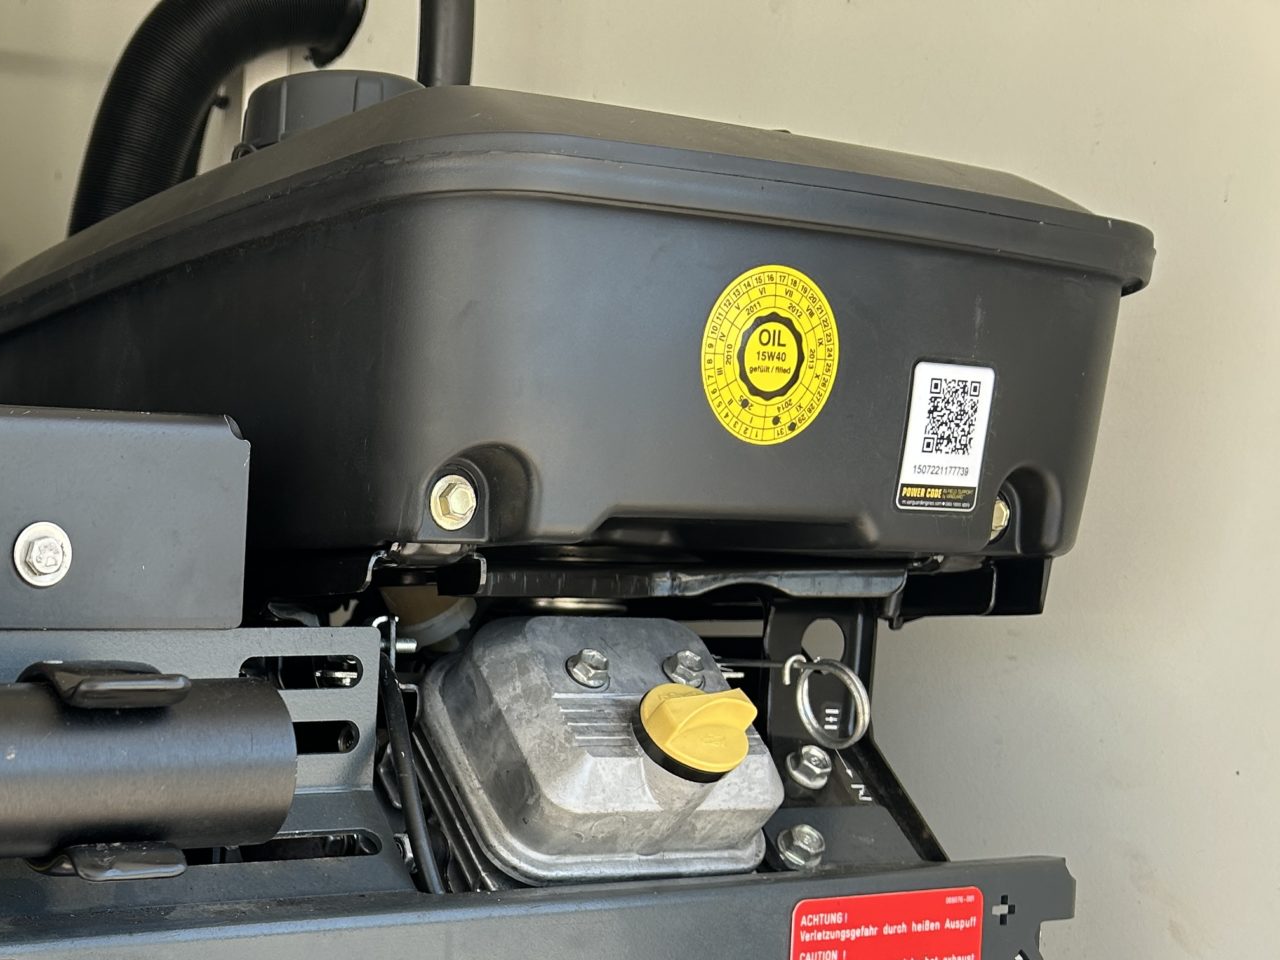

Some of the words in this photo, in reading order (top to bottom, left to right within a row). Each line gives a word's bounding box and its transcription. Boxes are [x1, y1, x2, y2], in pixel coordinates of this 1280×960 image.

[754, 276, 762, 284] 15
[790, 278, 798, 286] 18
[733, 289, 741, 297] 13
[800, 285, 808, 294] 19
[809, 294, 817, 303] 20
[724, 299, 732, 308] 12
[746, 302, 761, 315] 2011
[788, 304, 803, 319] 2012
[816, 305, 824, 314] 21
[716, 312, 724, 320] 11
[822, 318, 829, 327] 22
[711, 326, 718, 334] 10
[759, 330, 786, 347] OIL
[826, 333, 832, 344] 23
[757, 351, 786, 362] 15W40
[827, 348, 832, 357] 24
[824, 363, 831, 373] 25
[821, 377, 829, 388] 26
[816, 391, 823, 401] 27
[777, 399, 792, 413] 2014
[807, 404, 815, 413] 28
[798, 414, 806, 423] 29
[777, 428, 785, 436] 31
[902, 487, 925, 497] POWER
[926, 488, 942, 498] CODE
[800, 926, 879, 942] Verletzungsgefahr
[883, 923, 906, 934] durch
[912, 920, 940, 932] heißen
[945, 917, 976, 931] Auspuff
